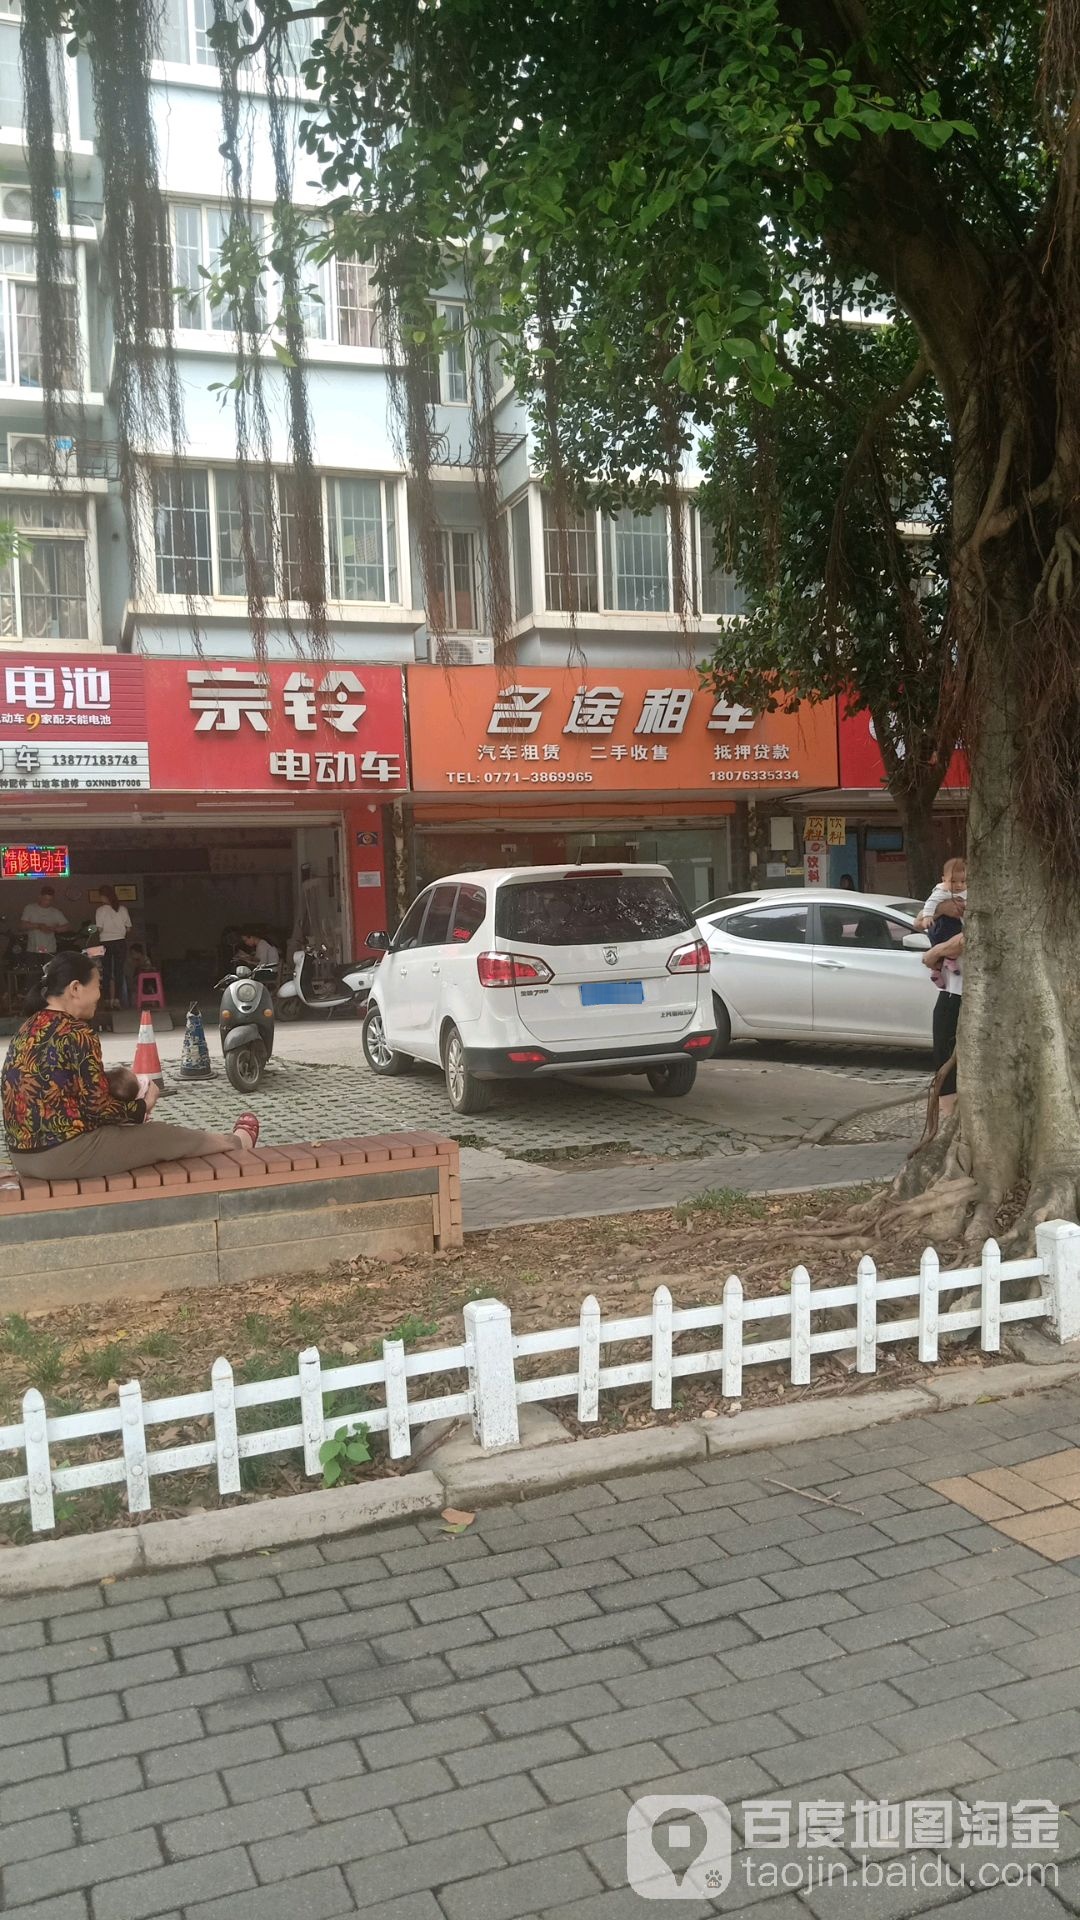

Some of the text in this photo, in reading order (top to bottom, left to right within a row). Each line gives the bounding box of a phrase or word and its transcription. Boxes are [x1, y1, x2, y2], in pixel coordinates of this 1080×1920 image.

[5, 666, 111, 710] 电池
[187, 667, 367, 733] 宗铃
[0, 712, 112, 730] 动车9家配天能电池
[486, 684, 756, 734] 名途租车
[52, 754, 138, 767] 13877183748
[477, 744, 790, 762] 汽车租赁 二手收售 抵押贷款
[269, 748, 401, 783] 电动车
[709, 770, 800, 781] 18076335334
[4, 849, 66, 873] 精修电动车
